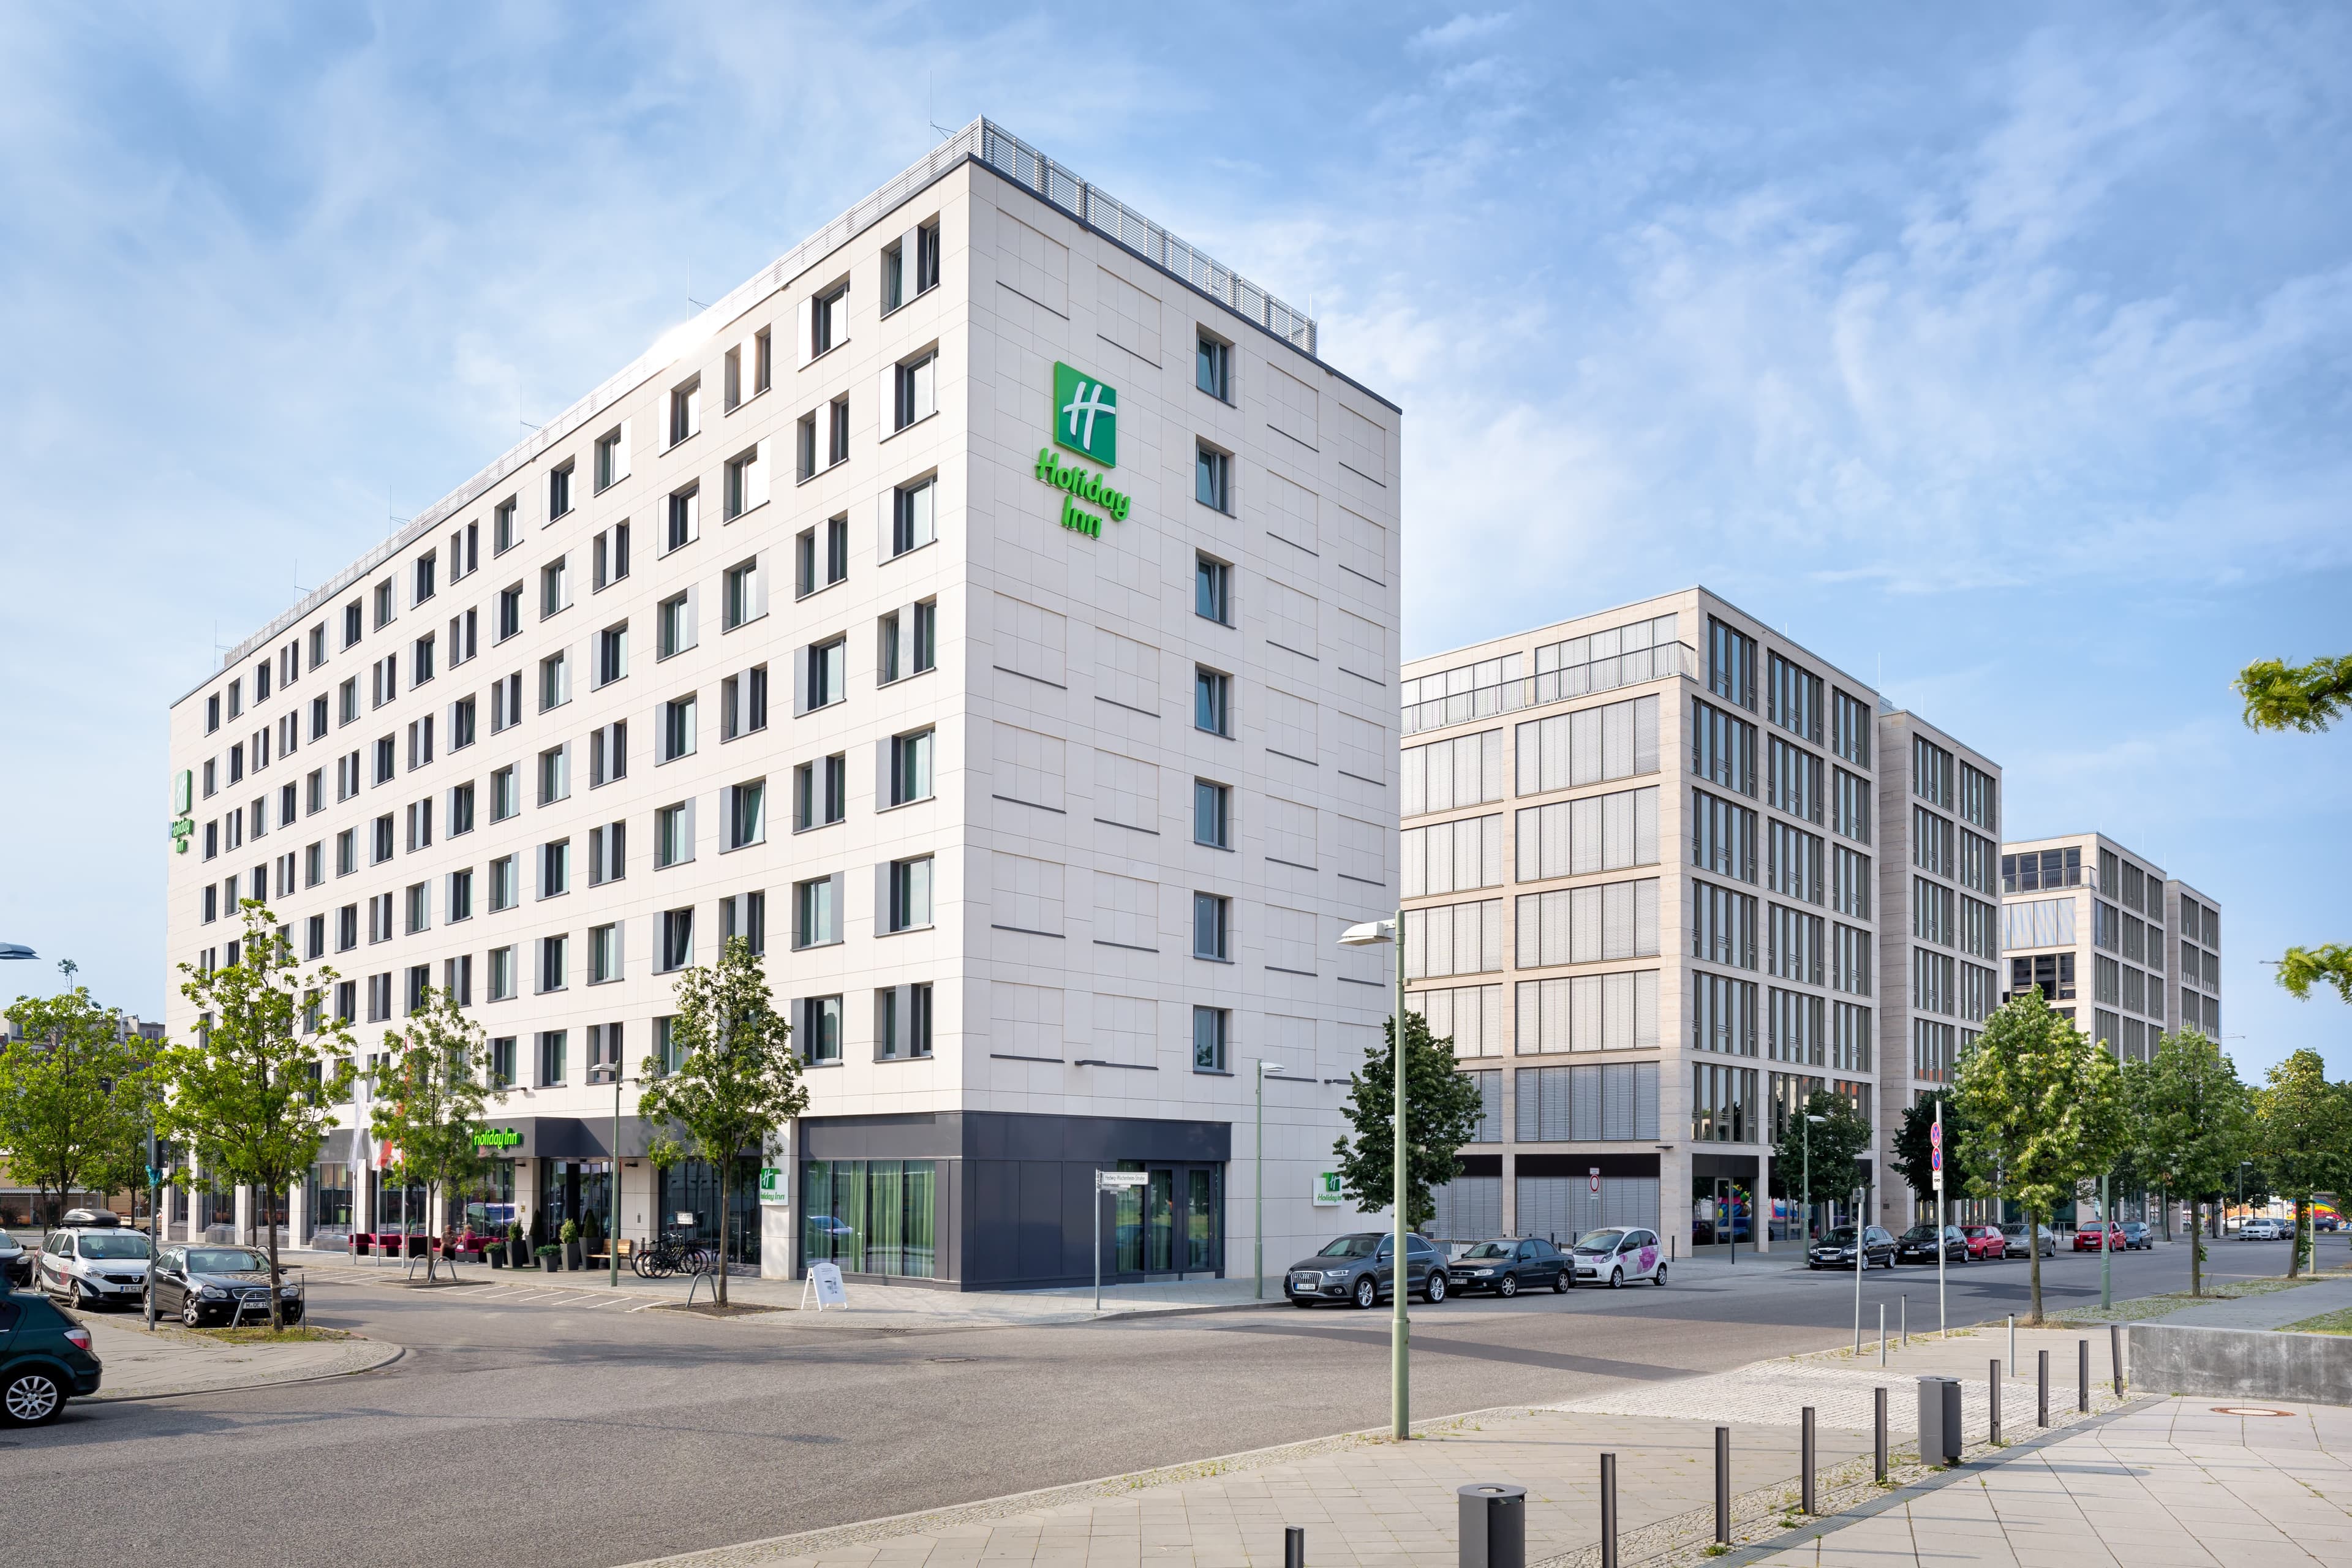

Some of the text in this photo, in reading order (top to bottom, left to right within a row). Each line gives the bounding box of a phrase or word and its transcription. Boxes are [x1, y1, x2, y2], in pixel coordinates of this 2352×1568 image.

[1035, 448, 1131, 521] Holiday
[1061, 494, 1102, 538] Inn
[172, 818, 192, 838] Holiday
[176, 837, 187, 853] Inn
[505, 1127, 519, 1145] Inn
[1317, 1193, 1337, 1202] Holiday
